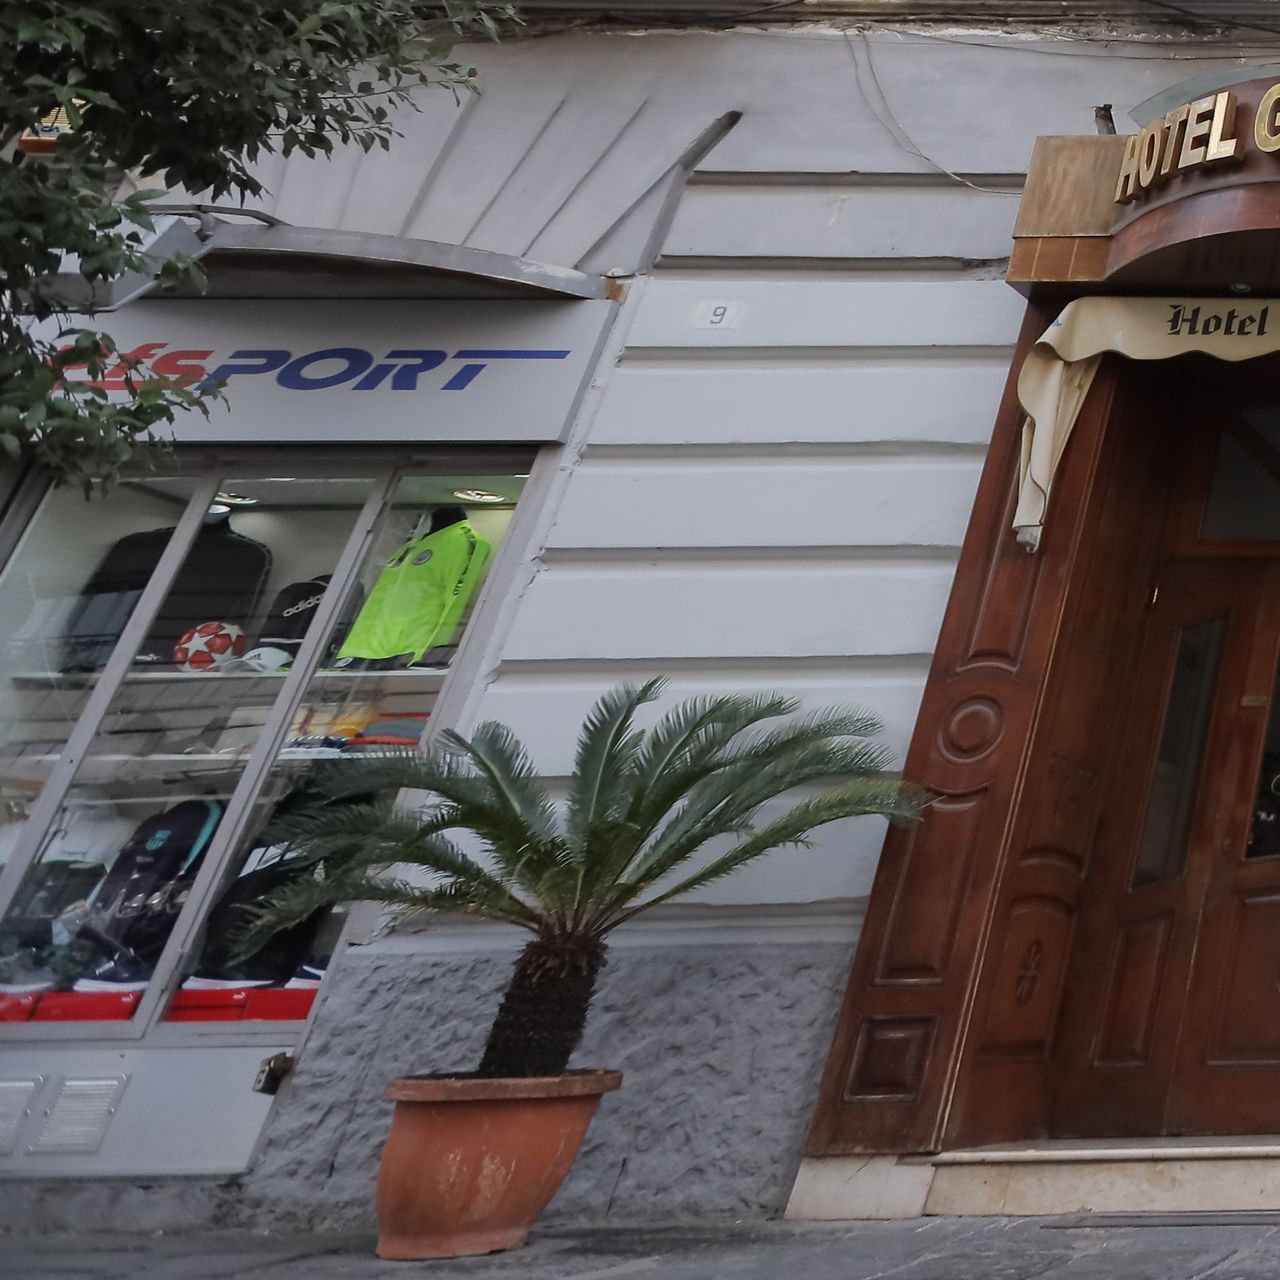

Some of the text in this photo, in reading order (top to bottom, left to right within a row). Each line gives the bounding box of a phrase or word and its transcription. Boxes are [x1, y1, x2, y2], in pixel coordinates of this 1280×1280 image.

[1114, 91, 1237, 203] HOTEL
[710, 306, 727, 325] 9
[1167, 304, 1269, 336] Hotel
[283, 594, 321, 617] adida
